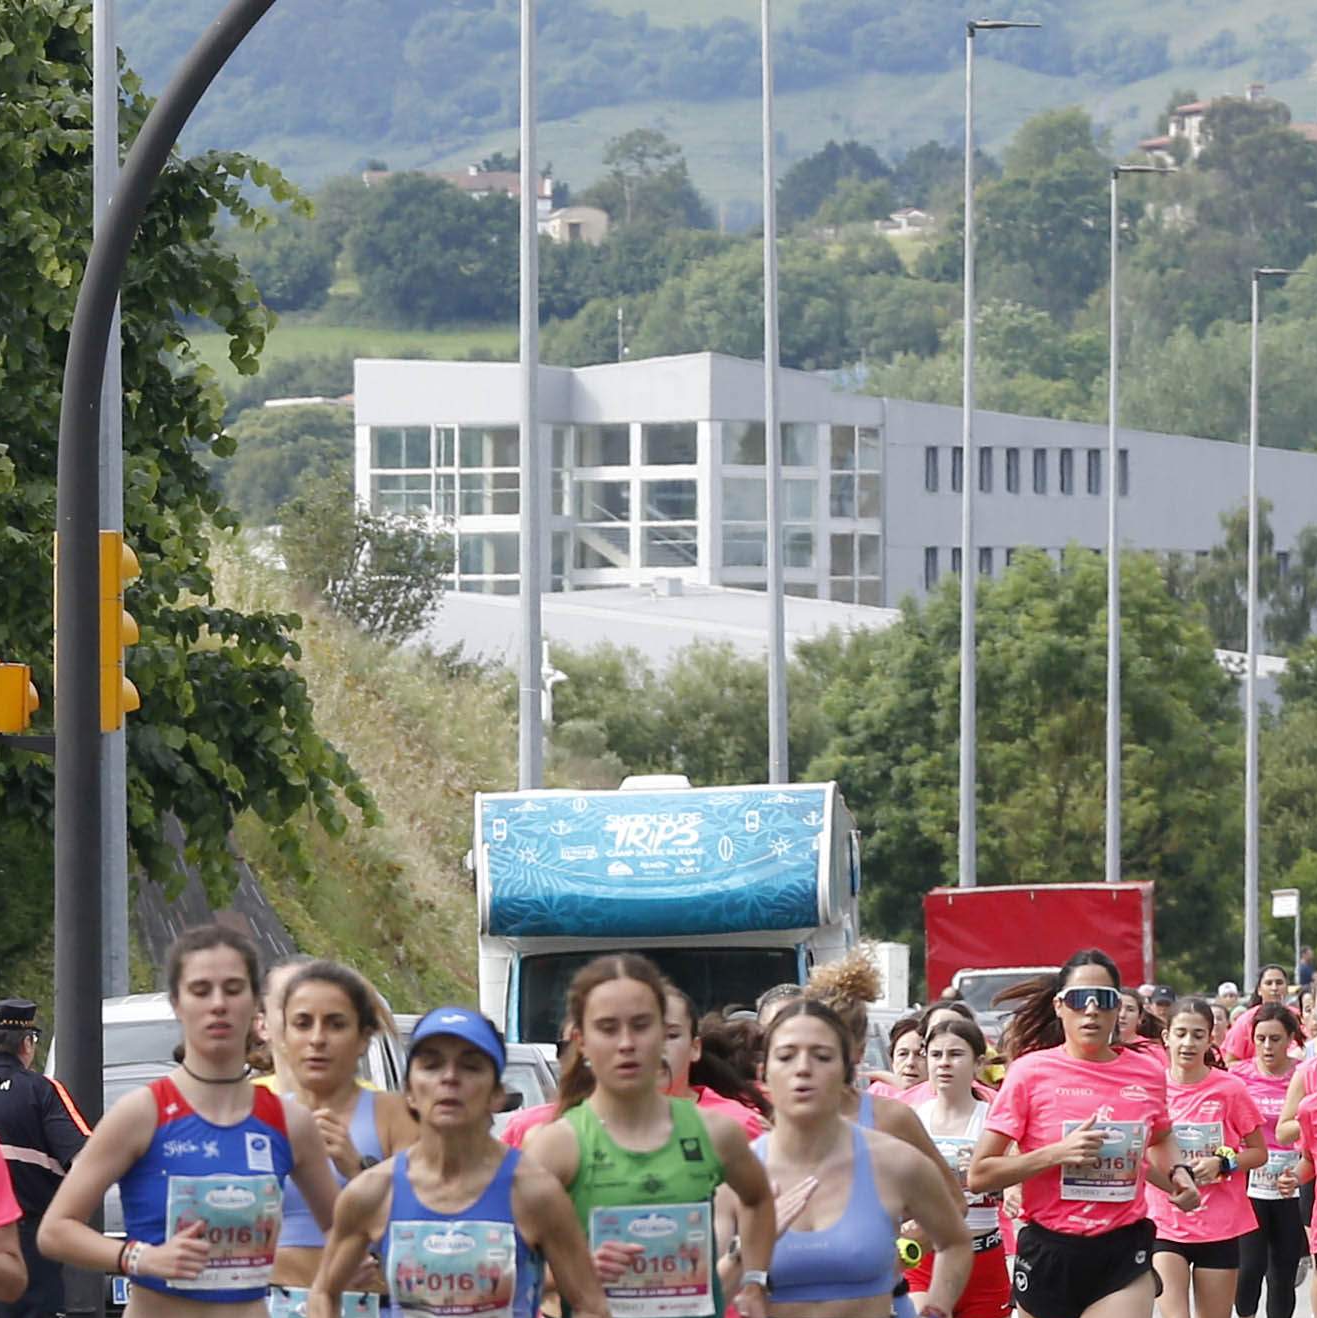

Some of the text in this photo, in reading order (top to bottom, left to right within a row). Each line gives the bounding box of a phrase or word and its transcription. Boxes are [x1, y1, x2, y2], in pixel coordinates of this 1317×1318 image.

[605, 818, 703, 852] TRIPS
[1093, 1157, 1124, 1170] 016
[209, 1226, 252, 1244] 016
[632, 1255, 677, 1274] 016
[427, 1272, 475, 1291] 016
